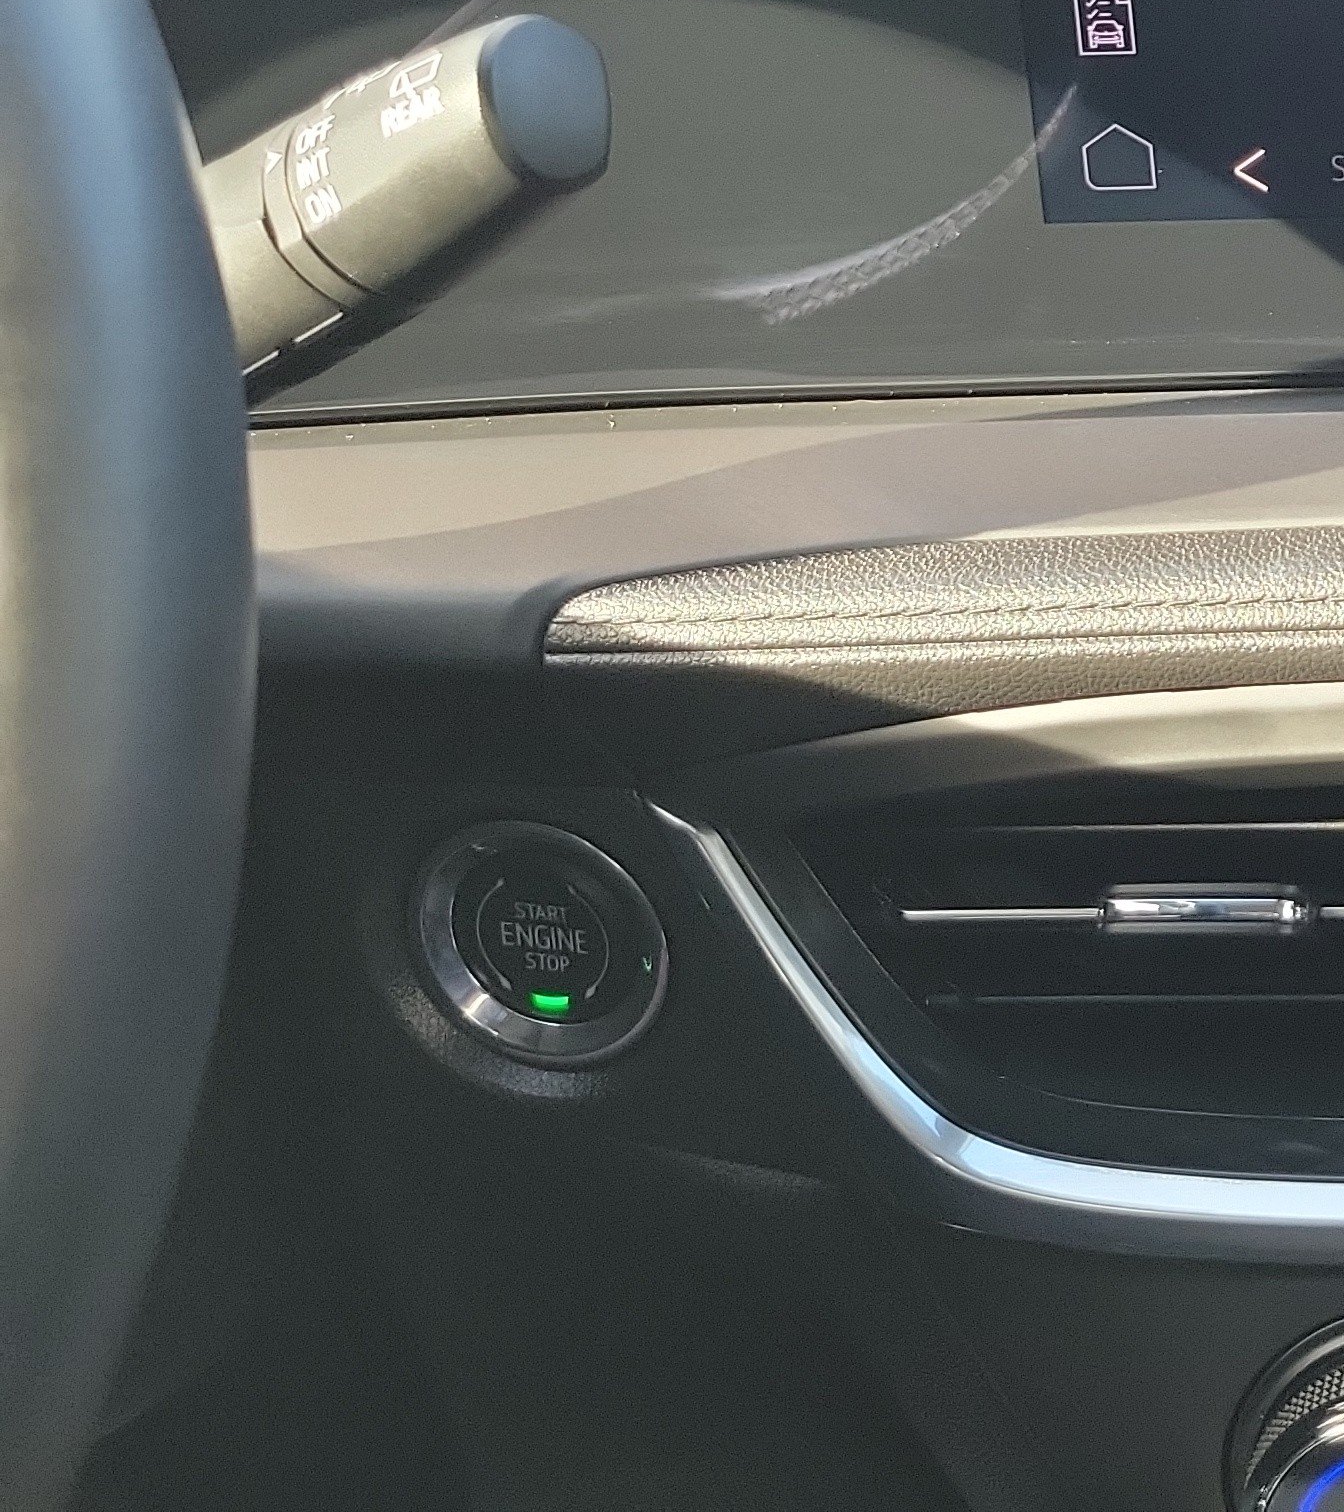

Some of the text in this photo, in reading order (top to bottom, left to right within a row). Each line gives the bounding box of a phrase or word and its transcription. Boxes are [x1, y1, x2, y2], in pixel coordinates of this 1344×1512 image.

[380, 86, 446, 138] REAR
[295, 113, 336, 155] OFF
[296, 147, 331, 189] INT
[304, 184, 342, 224] ON
[513, 901, 568, 923] START
[500, 921, 588, 954] ENGINE
[525, 951, 570, 972] STOP
